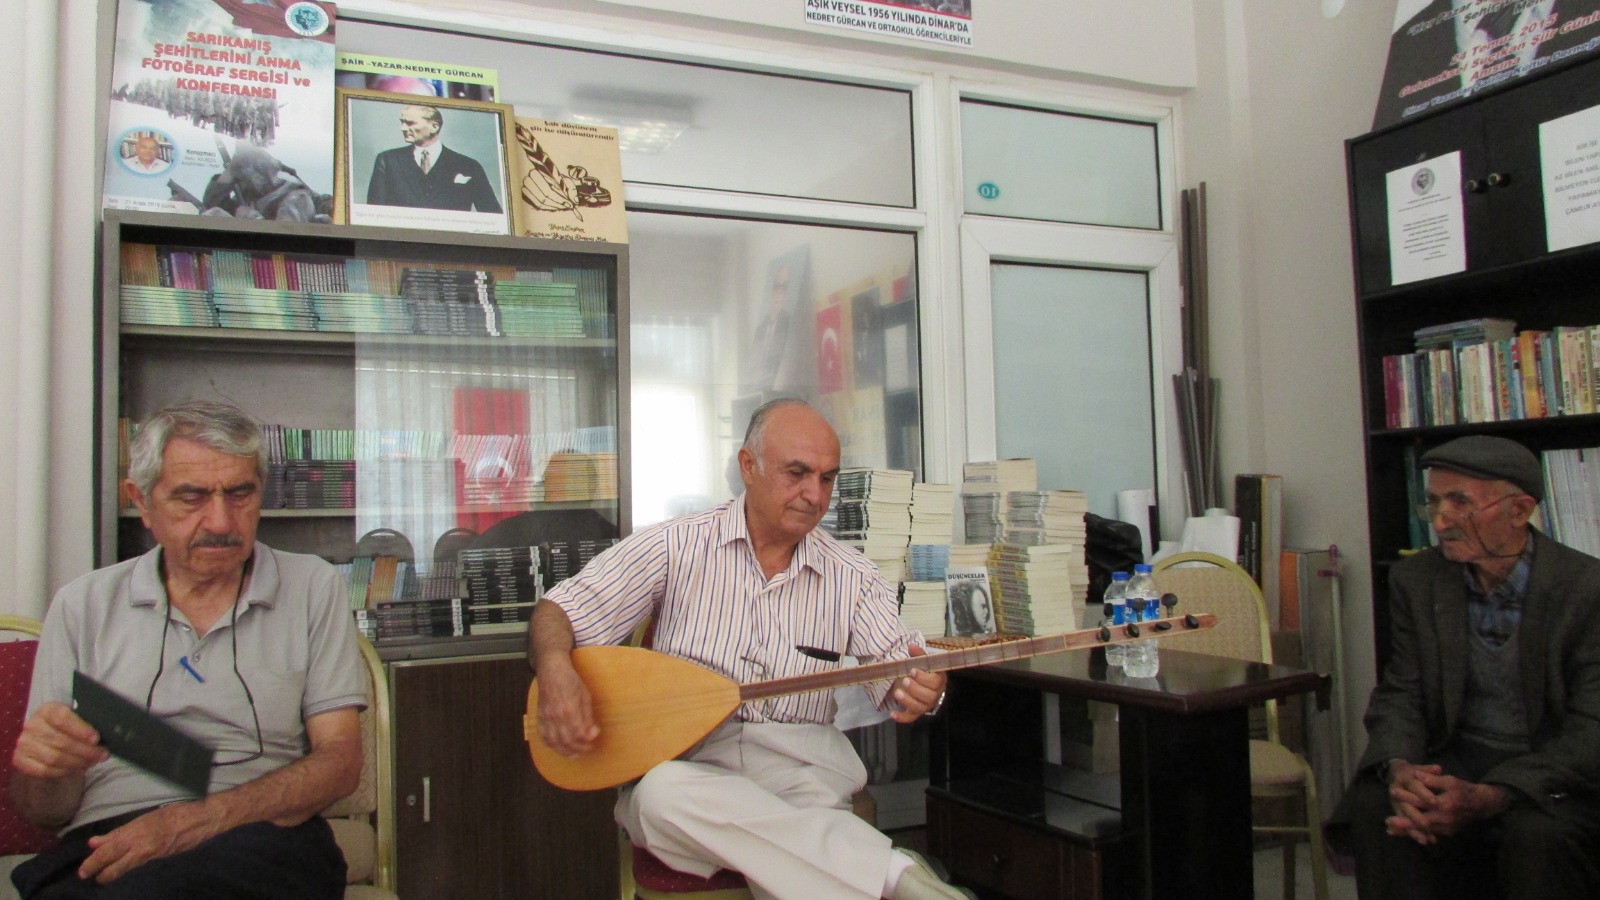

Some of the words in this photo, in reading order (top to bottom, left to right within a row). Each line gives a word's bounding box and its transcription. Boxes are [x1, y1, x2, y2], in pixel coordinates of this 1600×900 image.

[806, 12, 835, 24] NEDRET
[836, 15, 866, 28] GÜRCAN
[867, 20, 877, 30] VE
[878, 22, 915, 36] ORTAOKUL
[915, 26, 972, 46] ÖĞRENCİLERİYLE
[831, 1, 866, 16] VEYSEL
[868, 8, 890, 20] 1956
[891, 10, 927, 26] YILINDA
[928, 15, 969, 33] DİNAR'DA
[187, 31, 272, 55] SARIKAMIŞ
[153, 42, 252, 66] ŞEHİTLERİNİ
[256, 58, 301, 71] ANMA
[341, 57, 365, 67] ŞAİR
[445, 68, 484, 79] GÜRCAN
[141, 57, 225, 78] FOTOĞRAF
[229, 68, 289, 85] SERGİSİ
[293, 76, 311, 88] ve
[176, 77, 277, 100] KONFERANSI
[948, 572, 986, 580] DÜŞÜNCELER
